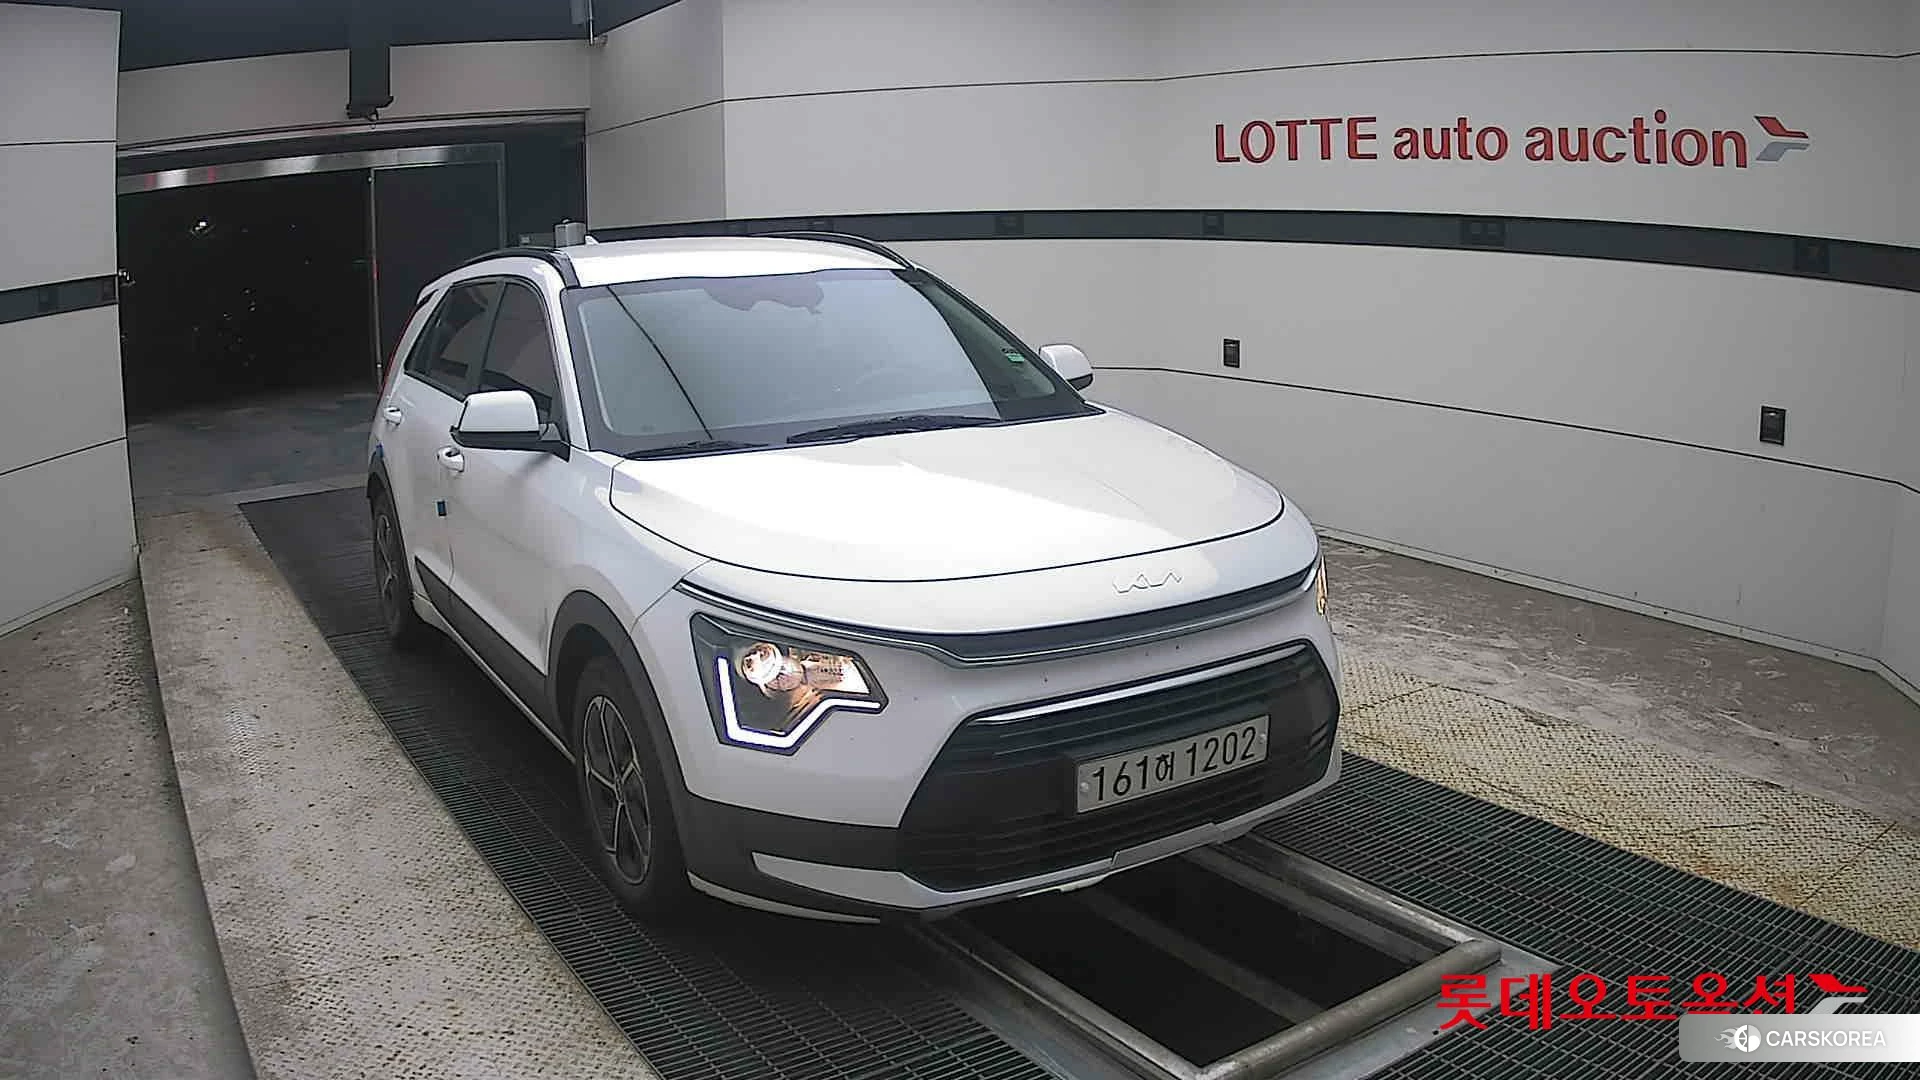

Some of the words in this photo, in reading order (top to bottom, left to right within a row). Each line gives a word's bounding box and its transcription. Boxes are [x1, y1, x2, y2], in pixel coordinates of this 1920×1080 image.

[1215, 116, 1377, 163] LOTTE
[1393, 117, 1508, 161] auto
[1525, 110, 1747, 168] auction
[1092, 751, 1175, 801] 161허
[1186, 726, 1256, 777] 1202
